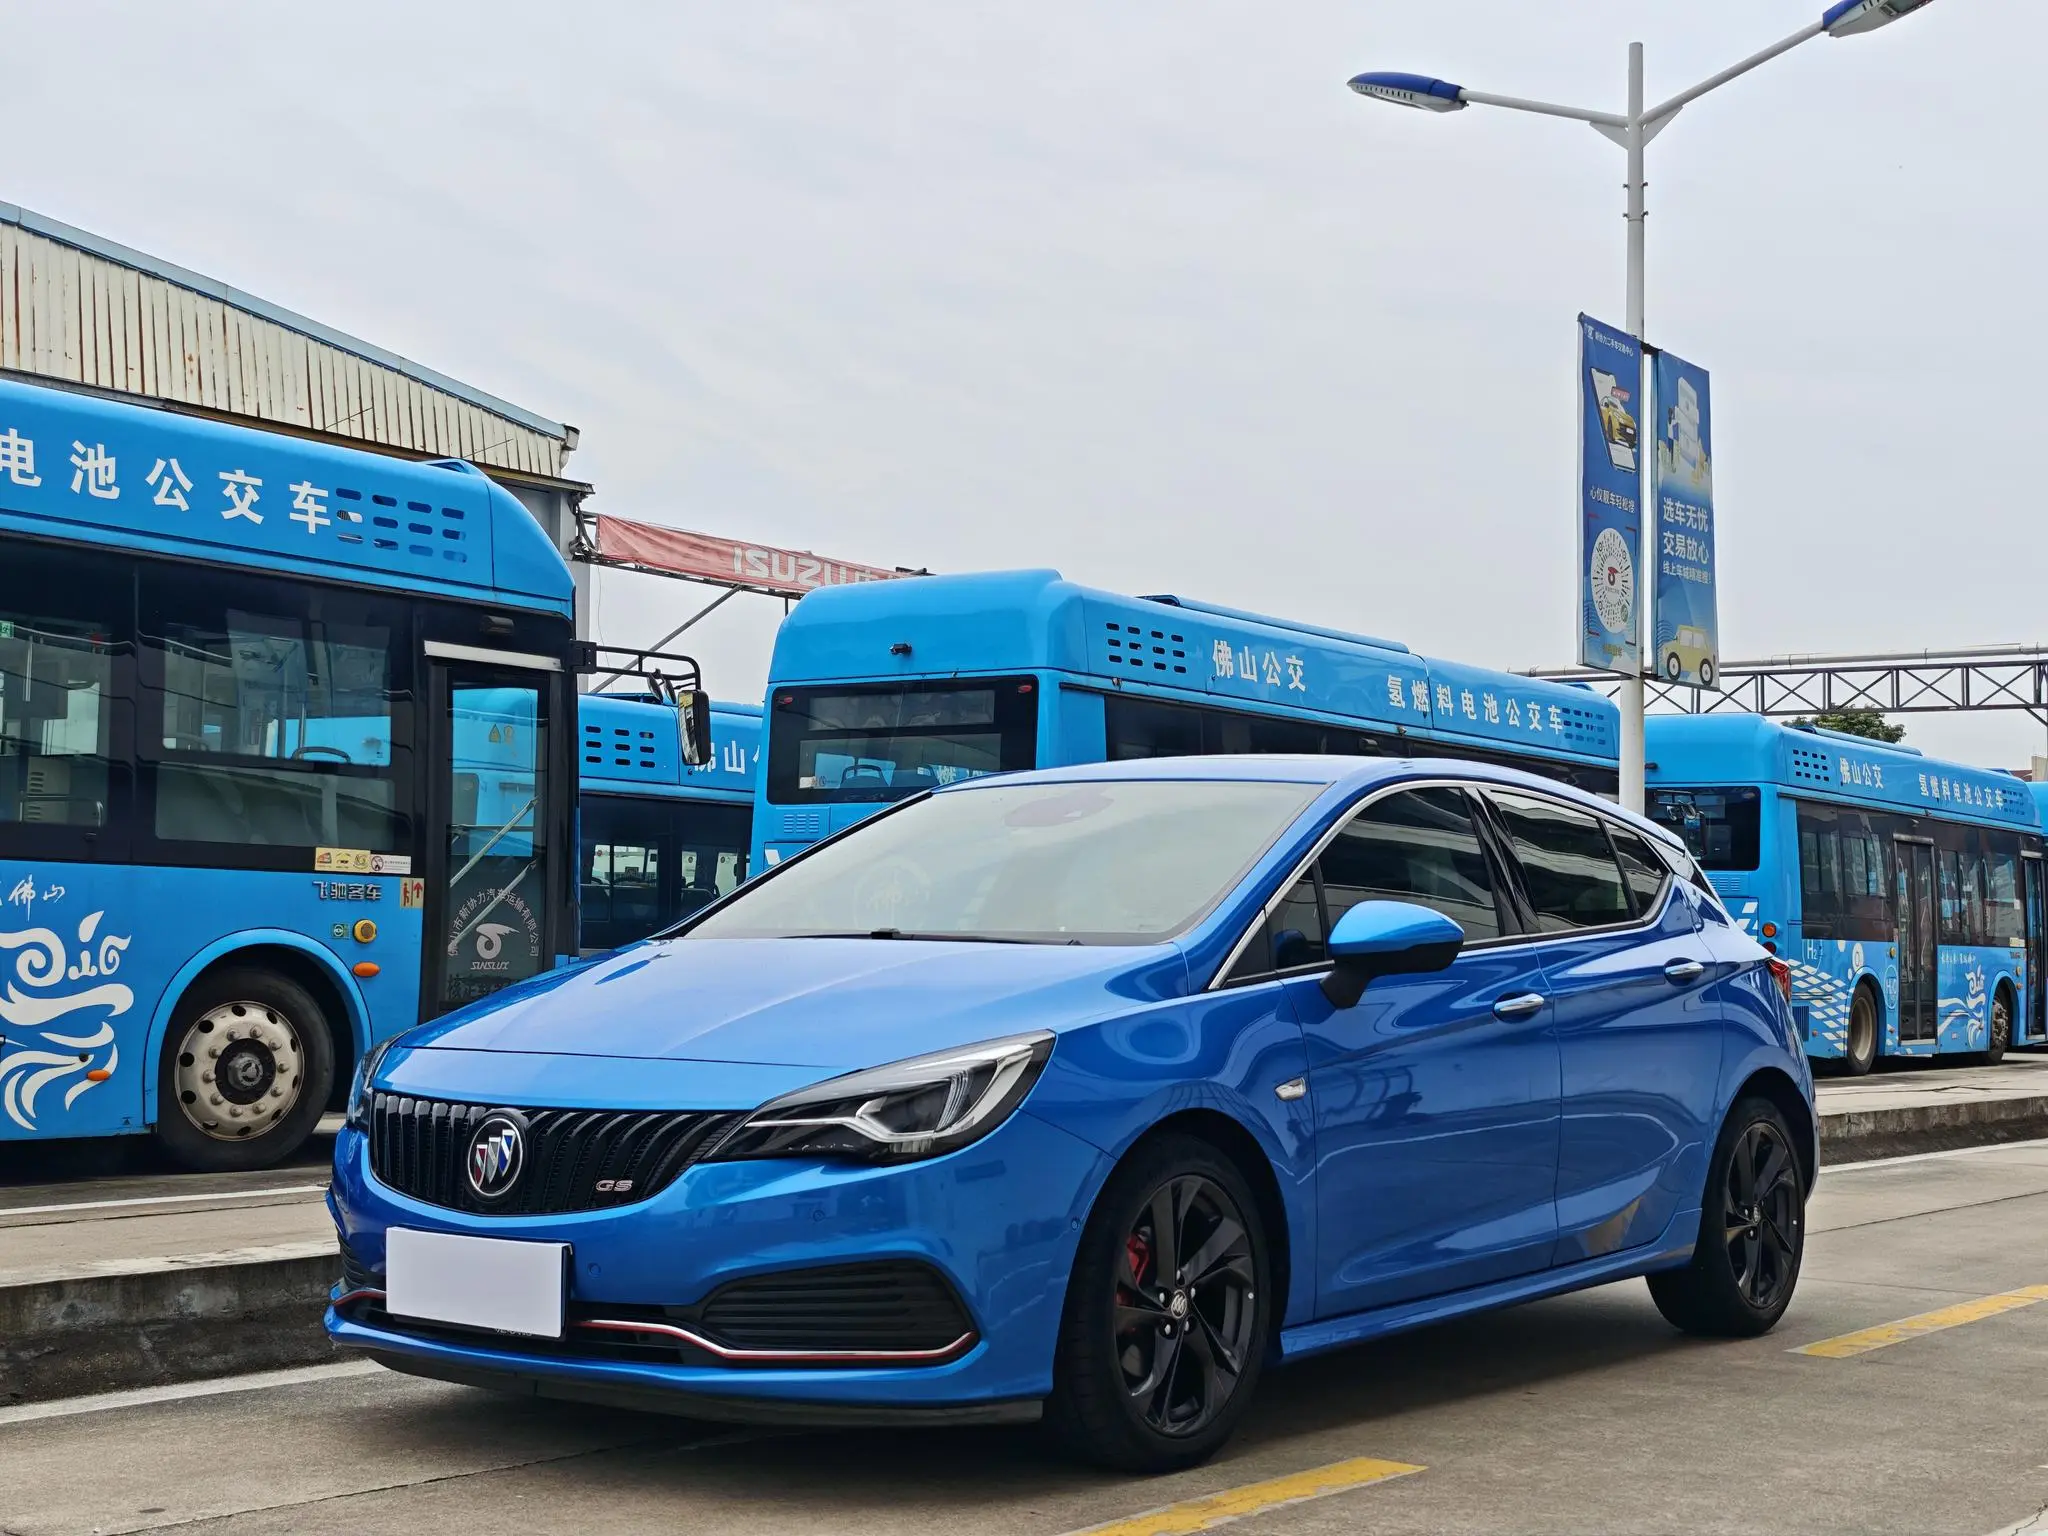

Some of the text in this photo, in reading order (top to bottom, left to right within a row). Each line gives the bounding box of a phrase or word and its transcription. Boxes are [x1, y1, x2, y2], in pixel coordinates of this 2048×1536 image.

[1663, 496, 1709, 532] 选车无忧
[1663, 530, 1709, 565] 交易放心
[733, 547, 847, 587] ISUZU
[1212, 639, 1307, 692] 佛山公交
[1387, 674, 1564, 736] 氢燃料电池公交车
[1839, 757, 1884, 789] 佛山公交
[312, 881, 382, 900] 飞驰客车
[595, 1179, 633, 1192] GS
